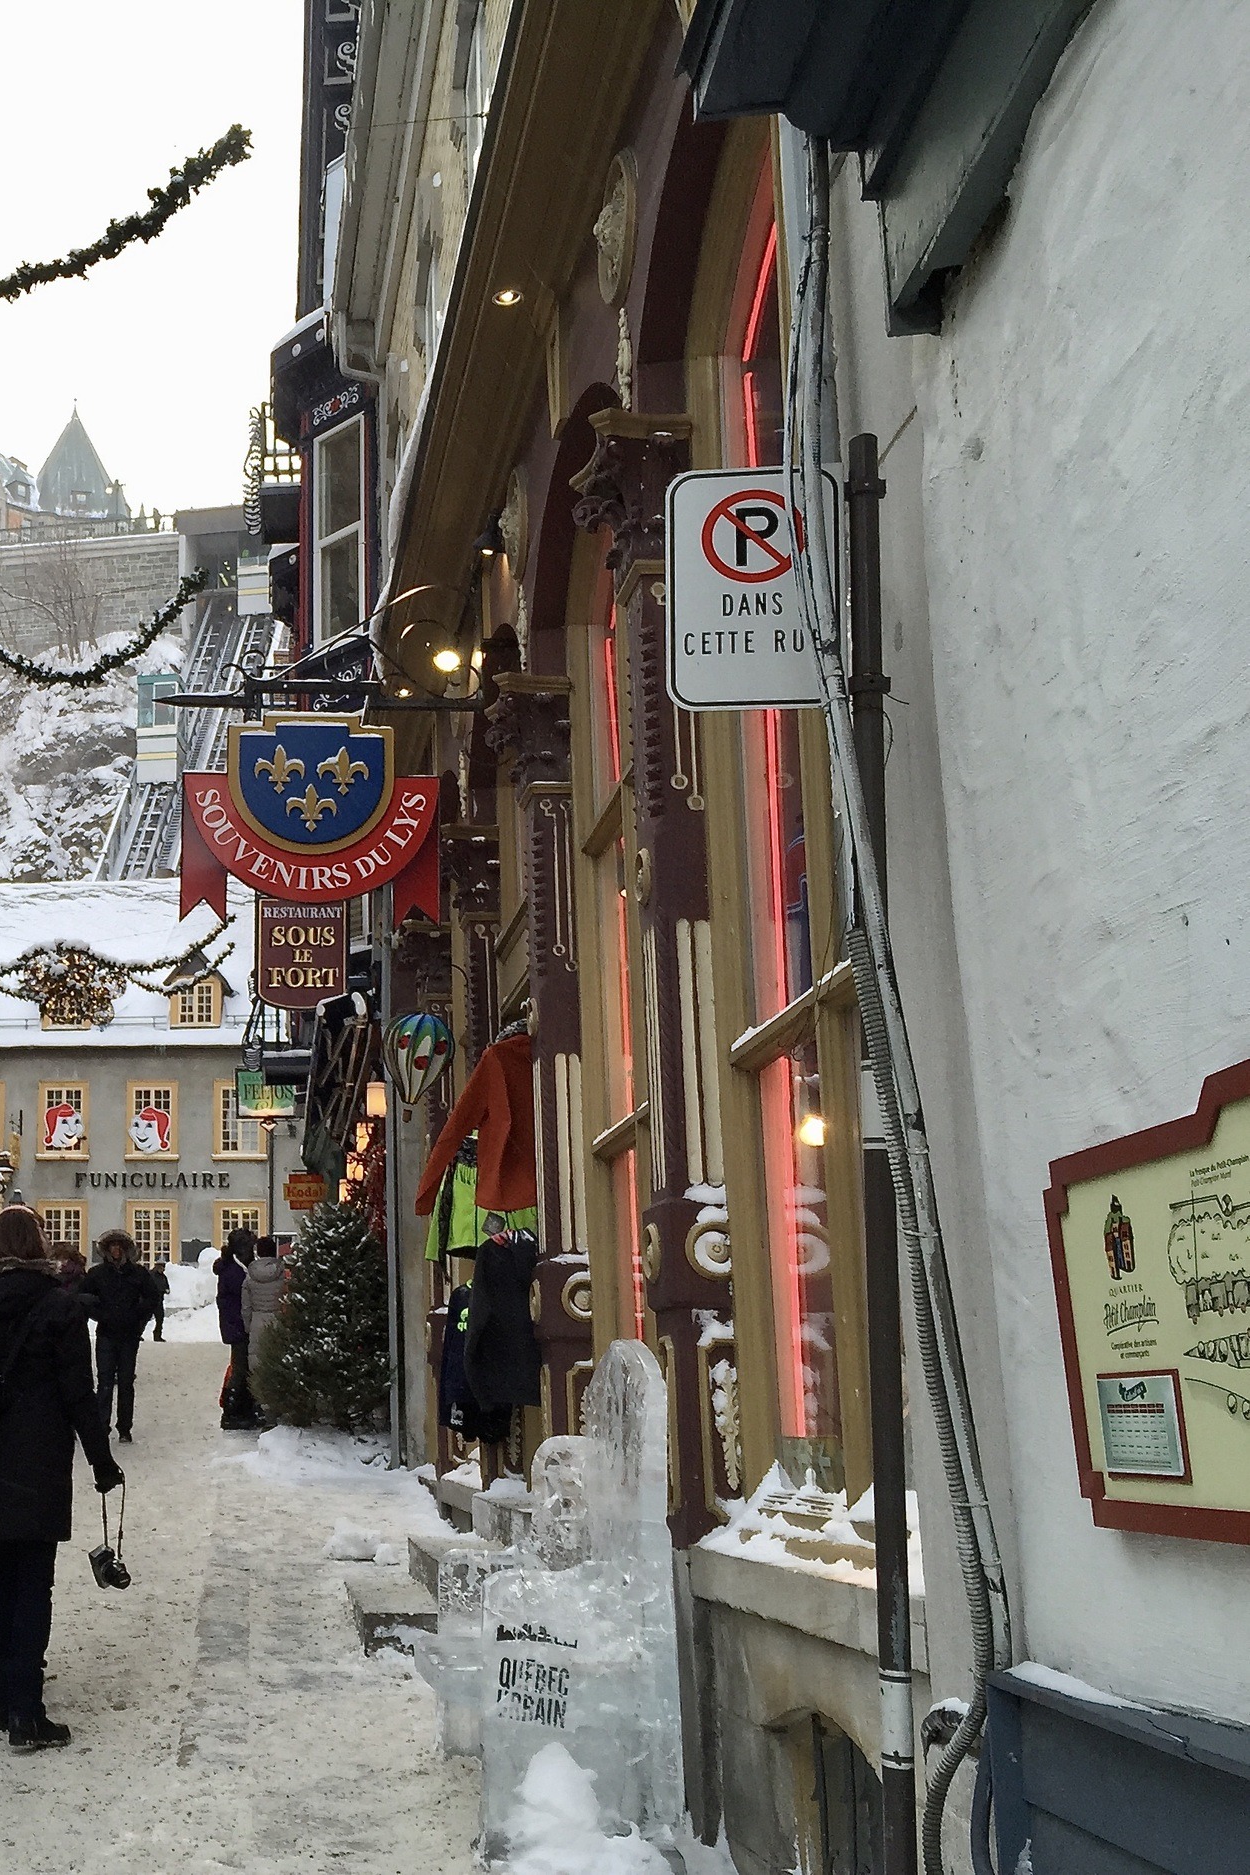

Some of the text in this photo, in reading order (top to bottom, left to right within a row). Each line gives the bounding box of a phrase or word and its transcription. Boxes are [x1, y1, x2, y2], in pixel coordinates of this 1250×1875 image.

[722, 592, 783, 617] DANS
[684, 630, 755, 655] CETTE
[196, 788, 427, 890] SOUVENIRS DU LYS
[263, 906, 343, 918] RESTAURANT
[271, 926, 336, 947] SOUS
[293, 948, 313, 963] LE
[268, 967, 339, 988] FORT
[75, 1171, 230, 1189] FUNICULAIRE
[1109, 1283, 1143, 1297] QUARTIER
[1120, 1294, 1157, 1332] Champlain
